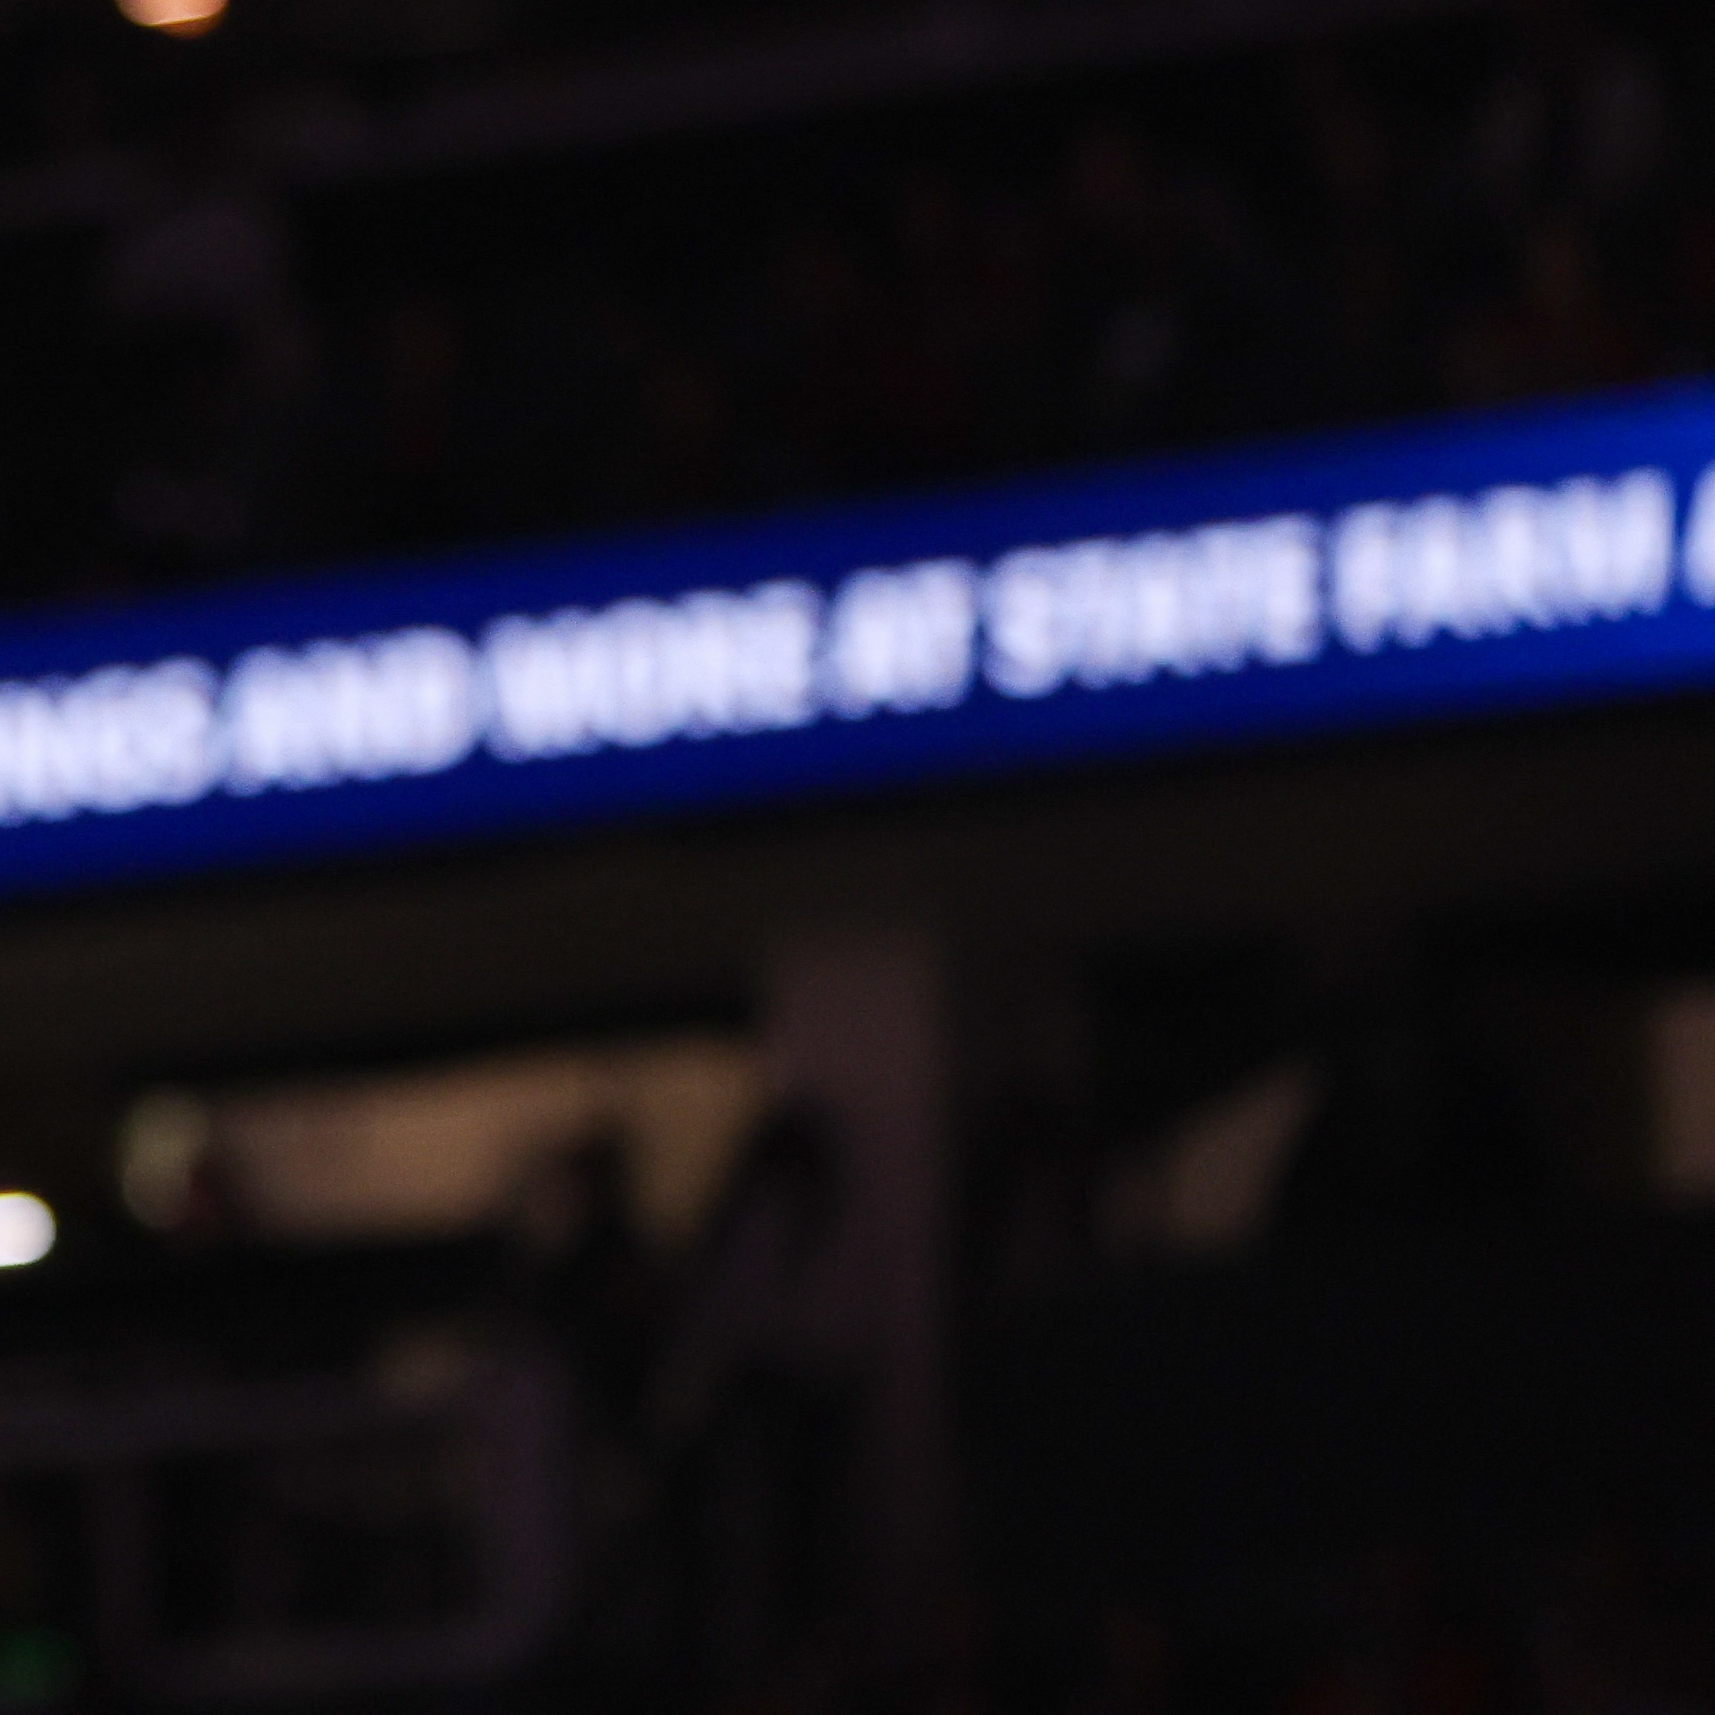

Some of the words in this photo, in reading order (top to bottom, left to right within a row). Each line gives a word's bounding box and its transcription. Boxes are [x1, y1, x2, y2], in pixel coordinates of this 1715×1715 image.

[223, 628, 476, 795] AND
[481, 580, 822, 762] MORE
[827, 557, 973, 718] AT
[982, 514, 1323, 696] STATE
[1332, 468, 1674, 650] FARM
